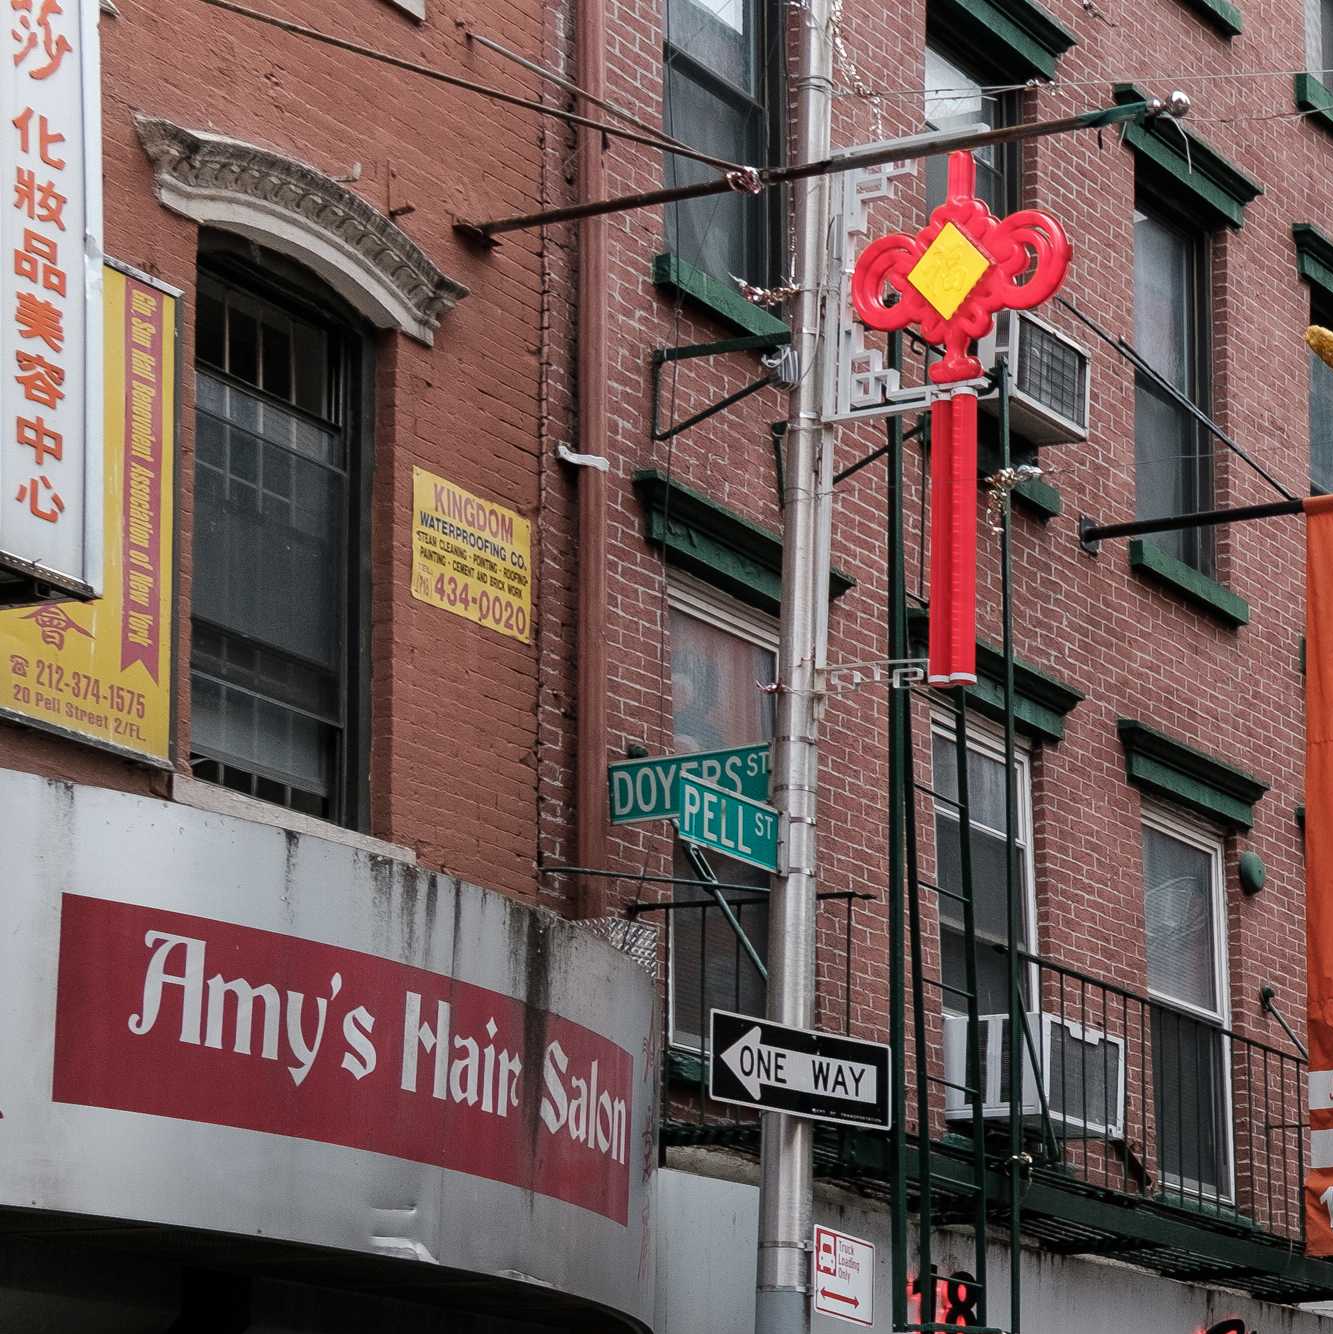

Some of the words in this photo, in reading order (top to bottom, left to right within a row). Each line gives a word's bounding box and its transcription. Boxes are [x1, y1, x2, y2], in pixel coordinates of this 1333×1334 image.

[131, 317, 156, 348] Sun
[130, 380, 156, 461] Benevolent
[129, 462, 155, 548] Association
[433, 483, 513, 545] KINGDOM
[420, 511, 507, 561] WATERPROOFING
[440, 538, 467, 560] CLEANING
[128, 550, 154, 570] of
[419, 546, 446, 566] PAINTING
[452, 560, 475, 577] CEMENT
[477, 570, 488, 585] AND
[490, 576, 505, 593] BRICK
[128, 570, 154, 607] New
[434, 573, 527, 635] 434-0020
[127, 610, 154, 647] York
[13, 684, 30, 704] 20
[35, 690, 61, 714] Pell
[65, 701, 110, 730] Street
[36, 658, 146, 719] 212-374-1575
[747, 750, 769, 776] ST
[683, 783, 752, 855] PELL
[754, 812, 772, 840] ST
[129, 930, 376, 1087] Amy's
[401, 991, 522, 1118] Hair
[540, 1039, 626, 1165] Salon
[739, 1044, 788, 1084] ONE
[812, 1059, 866, 1097] WAY
[838, 1255, 860, 1273] Loading
[839, 1240, 856, 1256] Truck
[839, 1268, 851, 1287] Only
